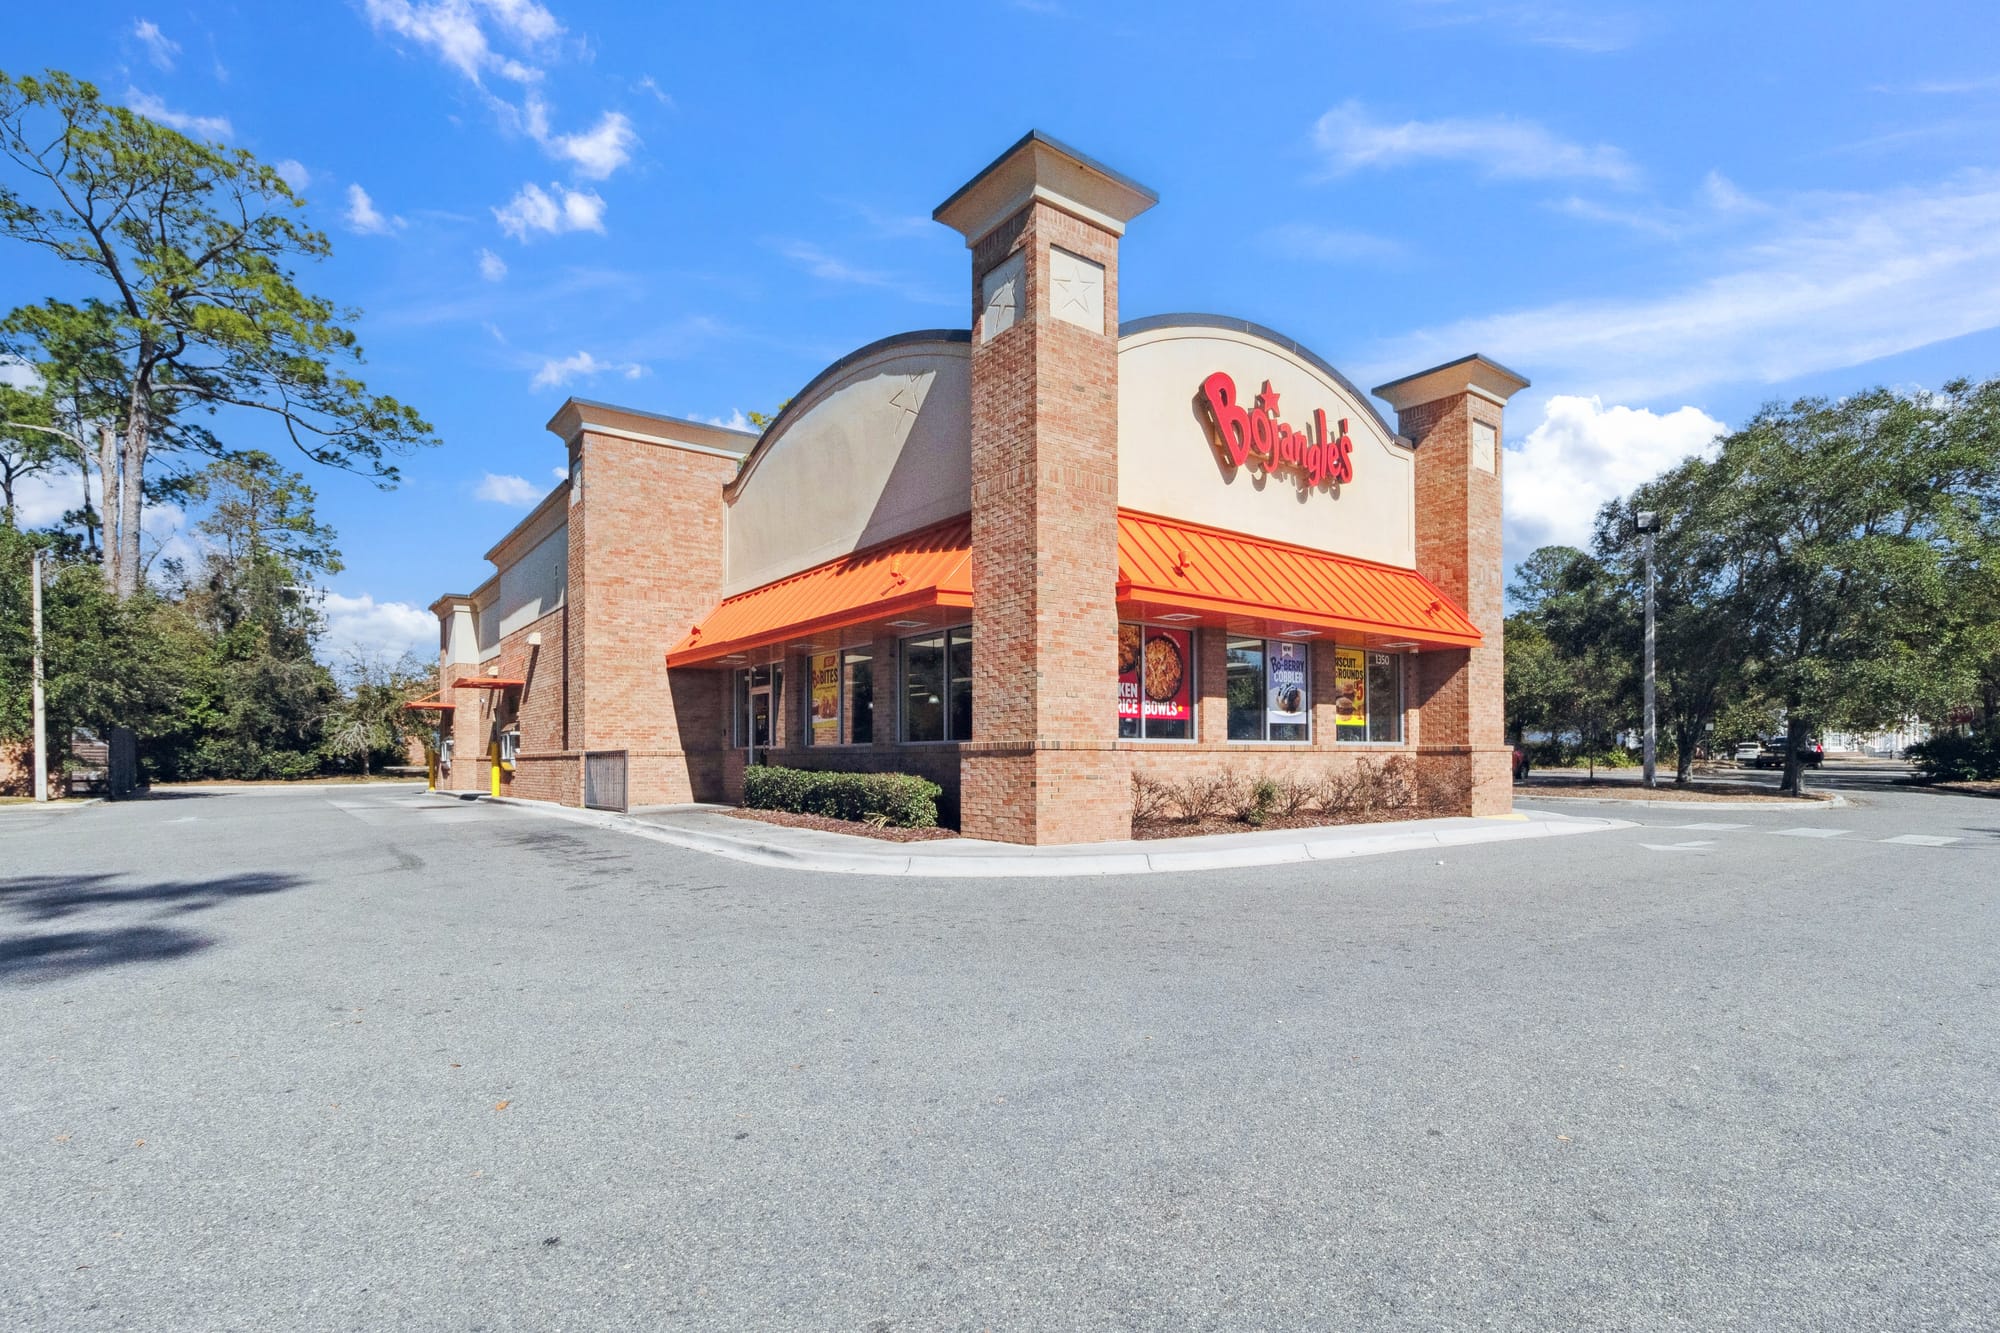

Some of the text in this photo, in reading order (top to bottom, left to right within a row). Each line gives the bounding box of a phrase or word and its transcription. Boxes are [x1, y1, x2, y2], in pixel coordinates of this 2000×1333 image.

[1335, 656, 1356, 668] ISCUIT
[1375, 653, 1390, 666] 1350
[1274, 670, 1303, 683] COBBLER
[1145, 700, 1178, 716] BOWLS
